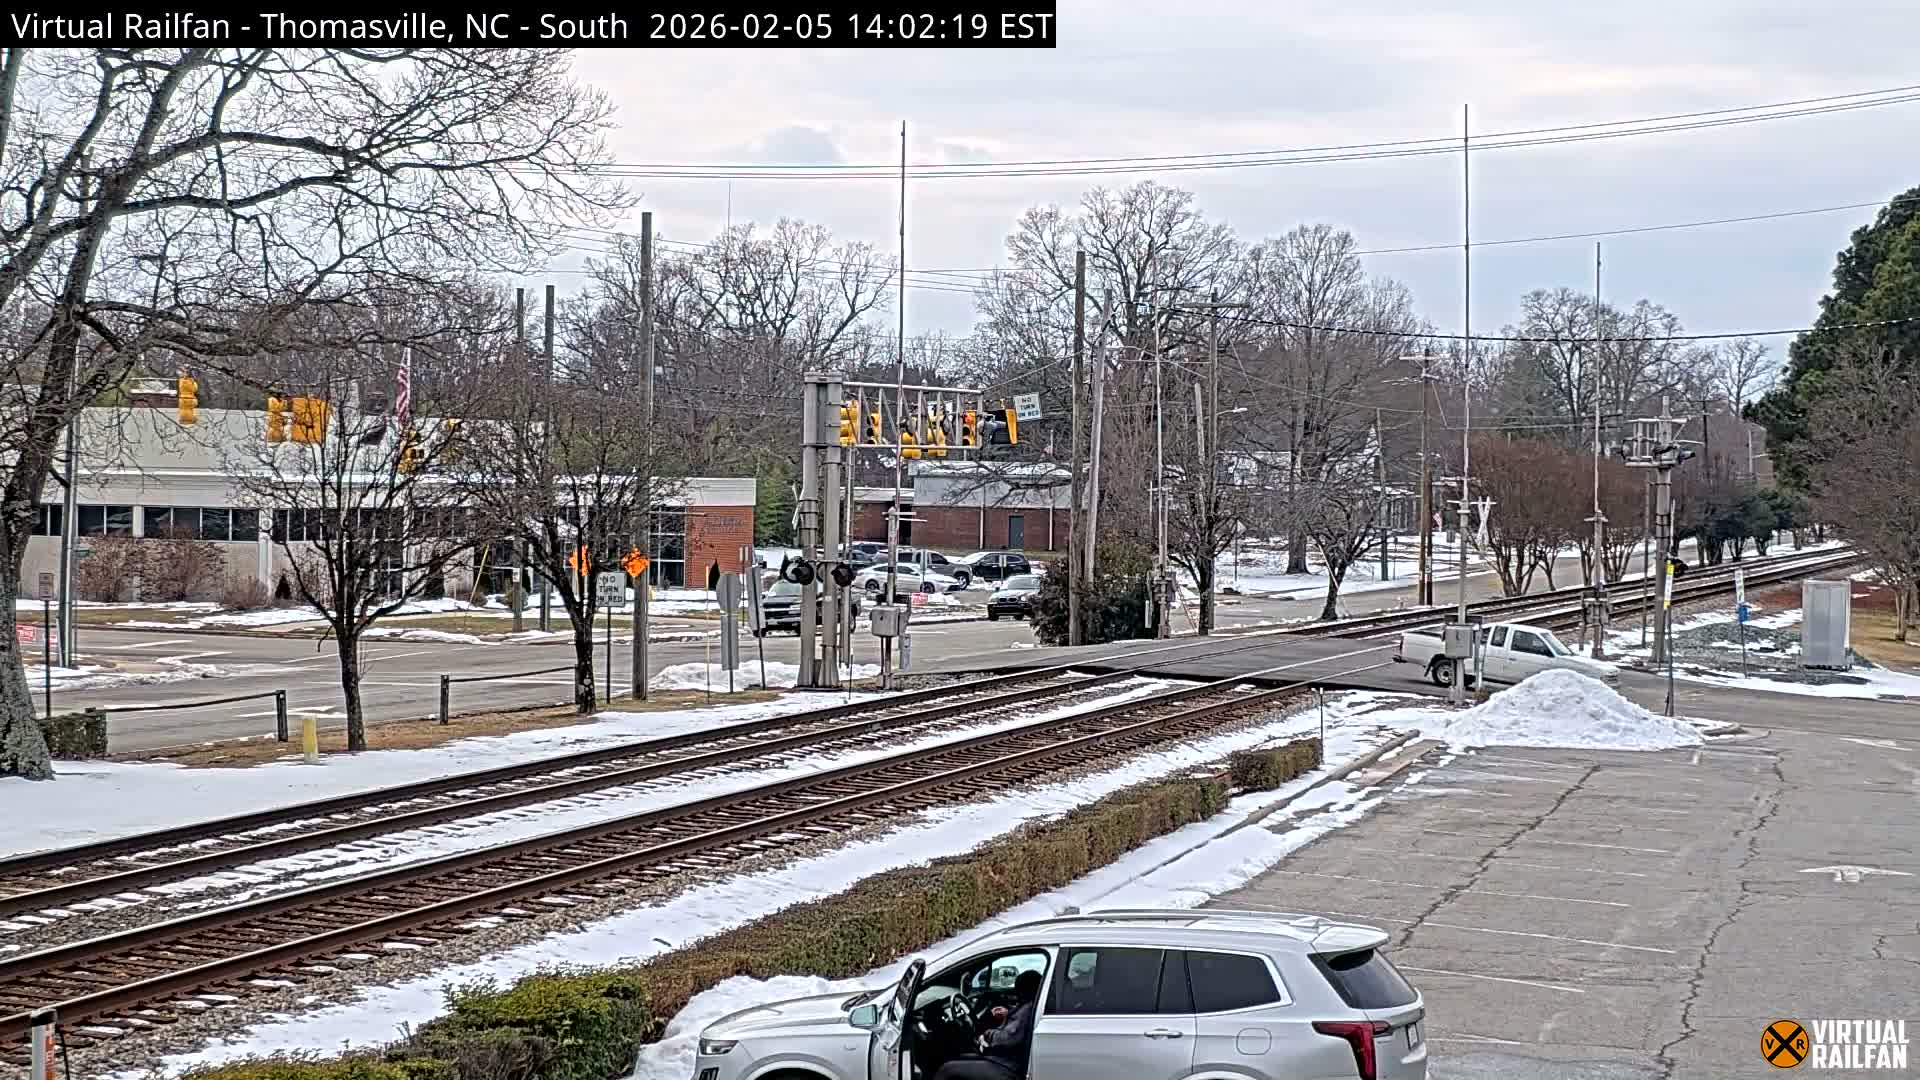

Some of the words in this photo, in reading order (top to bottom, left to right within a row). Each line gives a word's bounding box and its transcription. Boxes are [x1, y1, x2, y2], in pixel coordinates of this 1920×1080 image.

[602, 575, 616, 583] NO
[599, 585, 619, 593] TURN
[608, 595, 623, 603] RED
